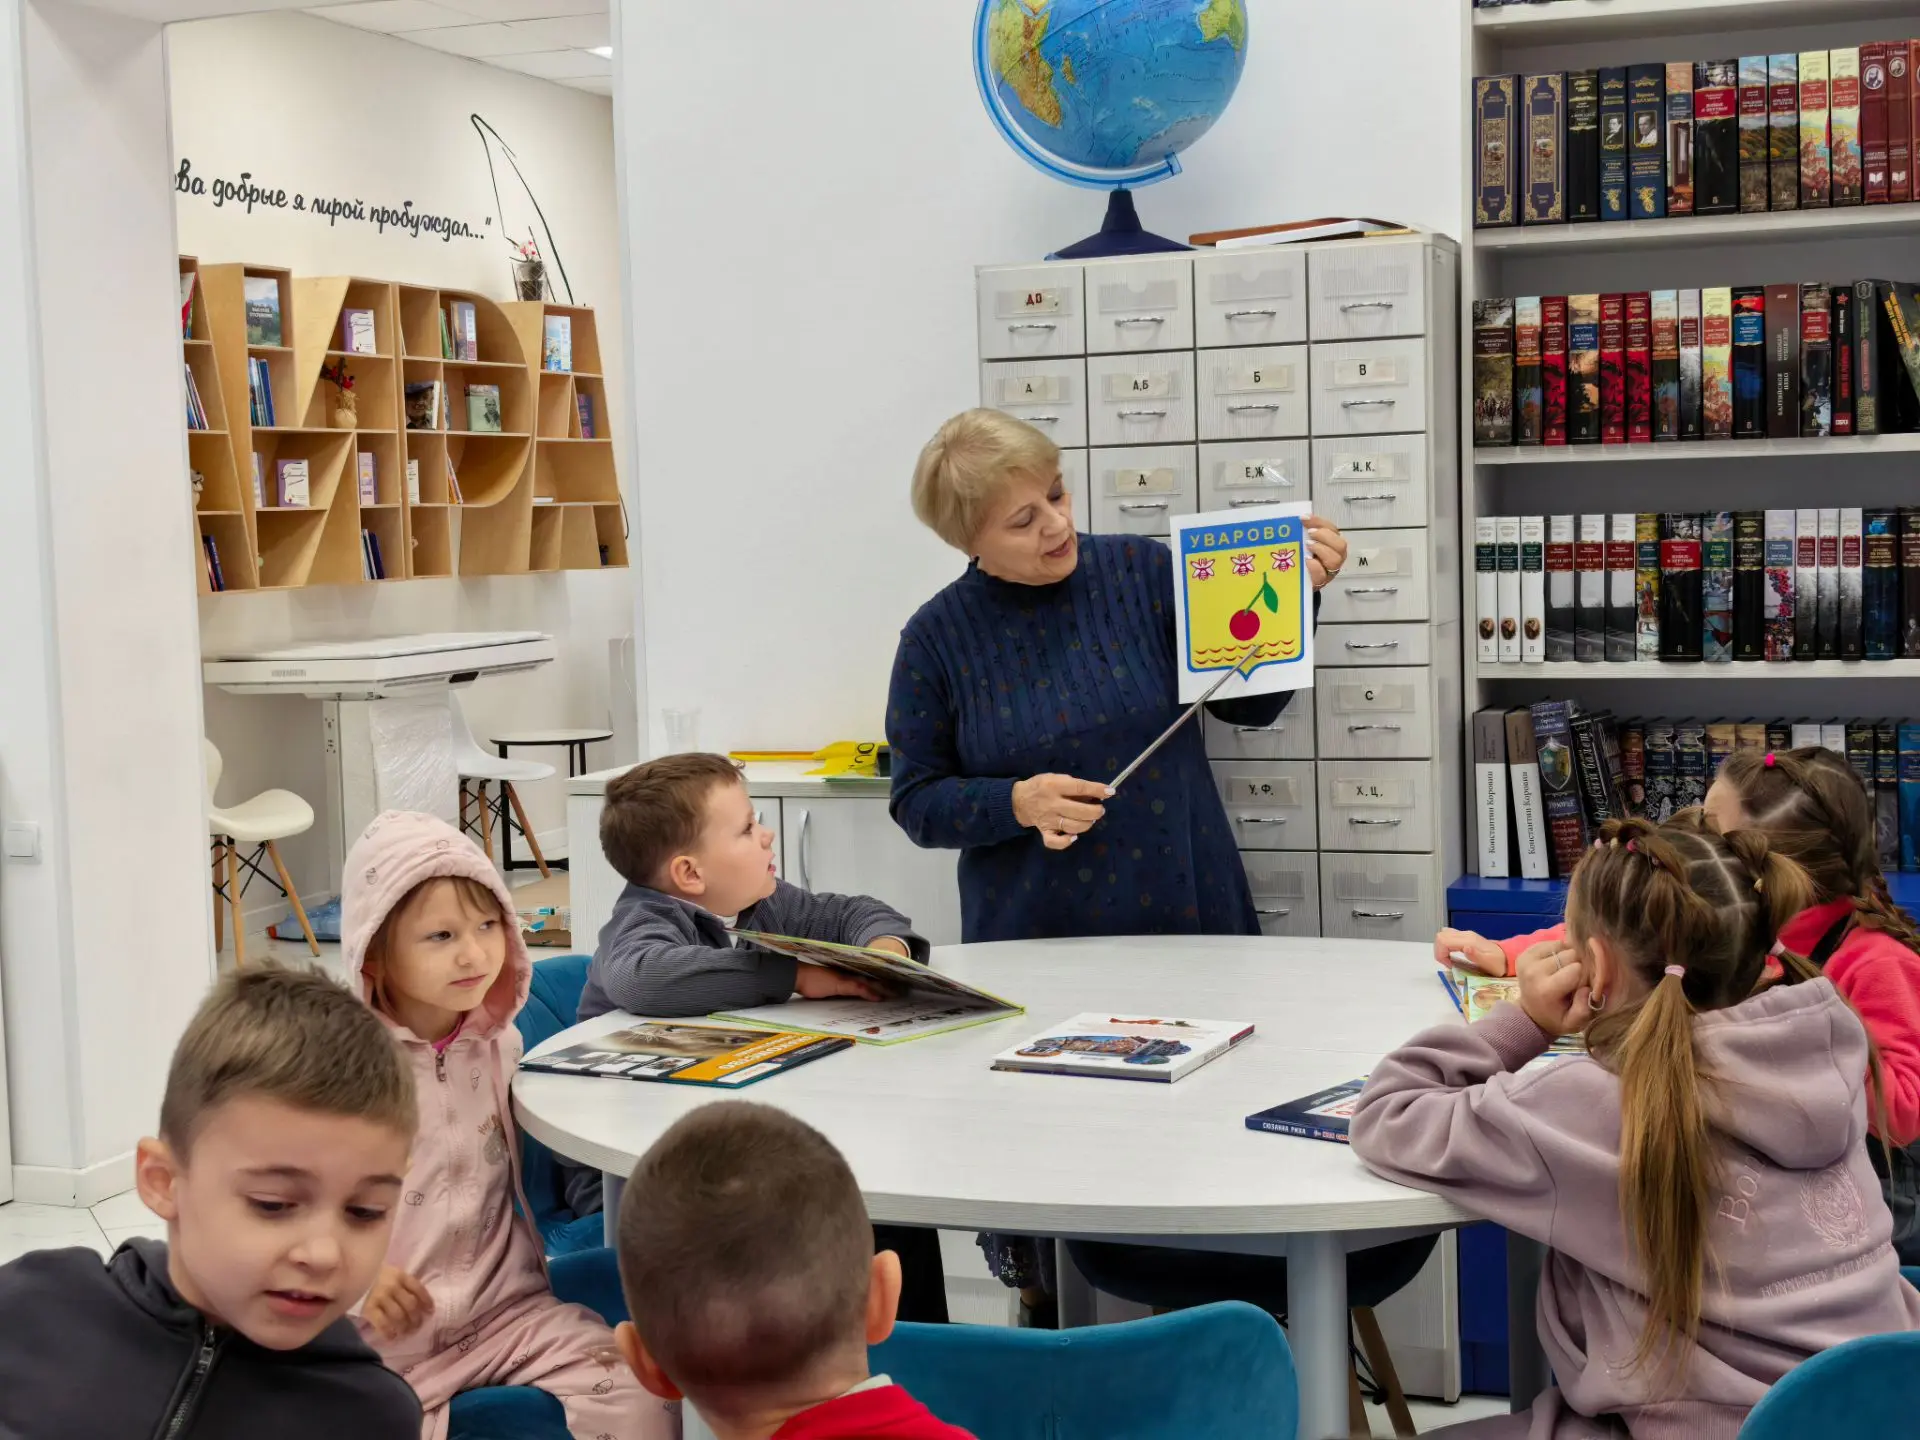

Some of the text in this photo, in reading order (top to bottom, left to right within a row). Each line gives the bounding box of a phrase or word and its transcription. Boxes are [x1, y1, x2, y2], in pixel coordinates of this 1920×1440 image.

[175, 158, 206, 195] ва
[212, 172, 288, 214] добрые
[293, 194, 306, 210] я
[311, 198, 366, 227] лирой
[1253, 371, 1261, 383] Б
[1359, 364, 1367, 376] В
[1190, 524, 1292, 549] УВАРОВО
[1358, 556, 1369, 567] М
[1364, 690, 1374, 701] С
[1486, 771, 1496, 854] Константин Коровин
[1522, 771, 1536, 855] Константин Коровин
